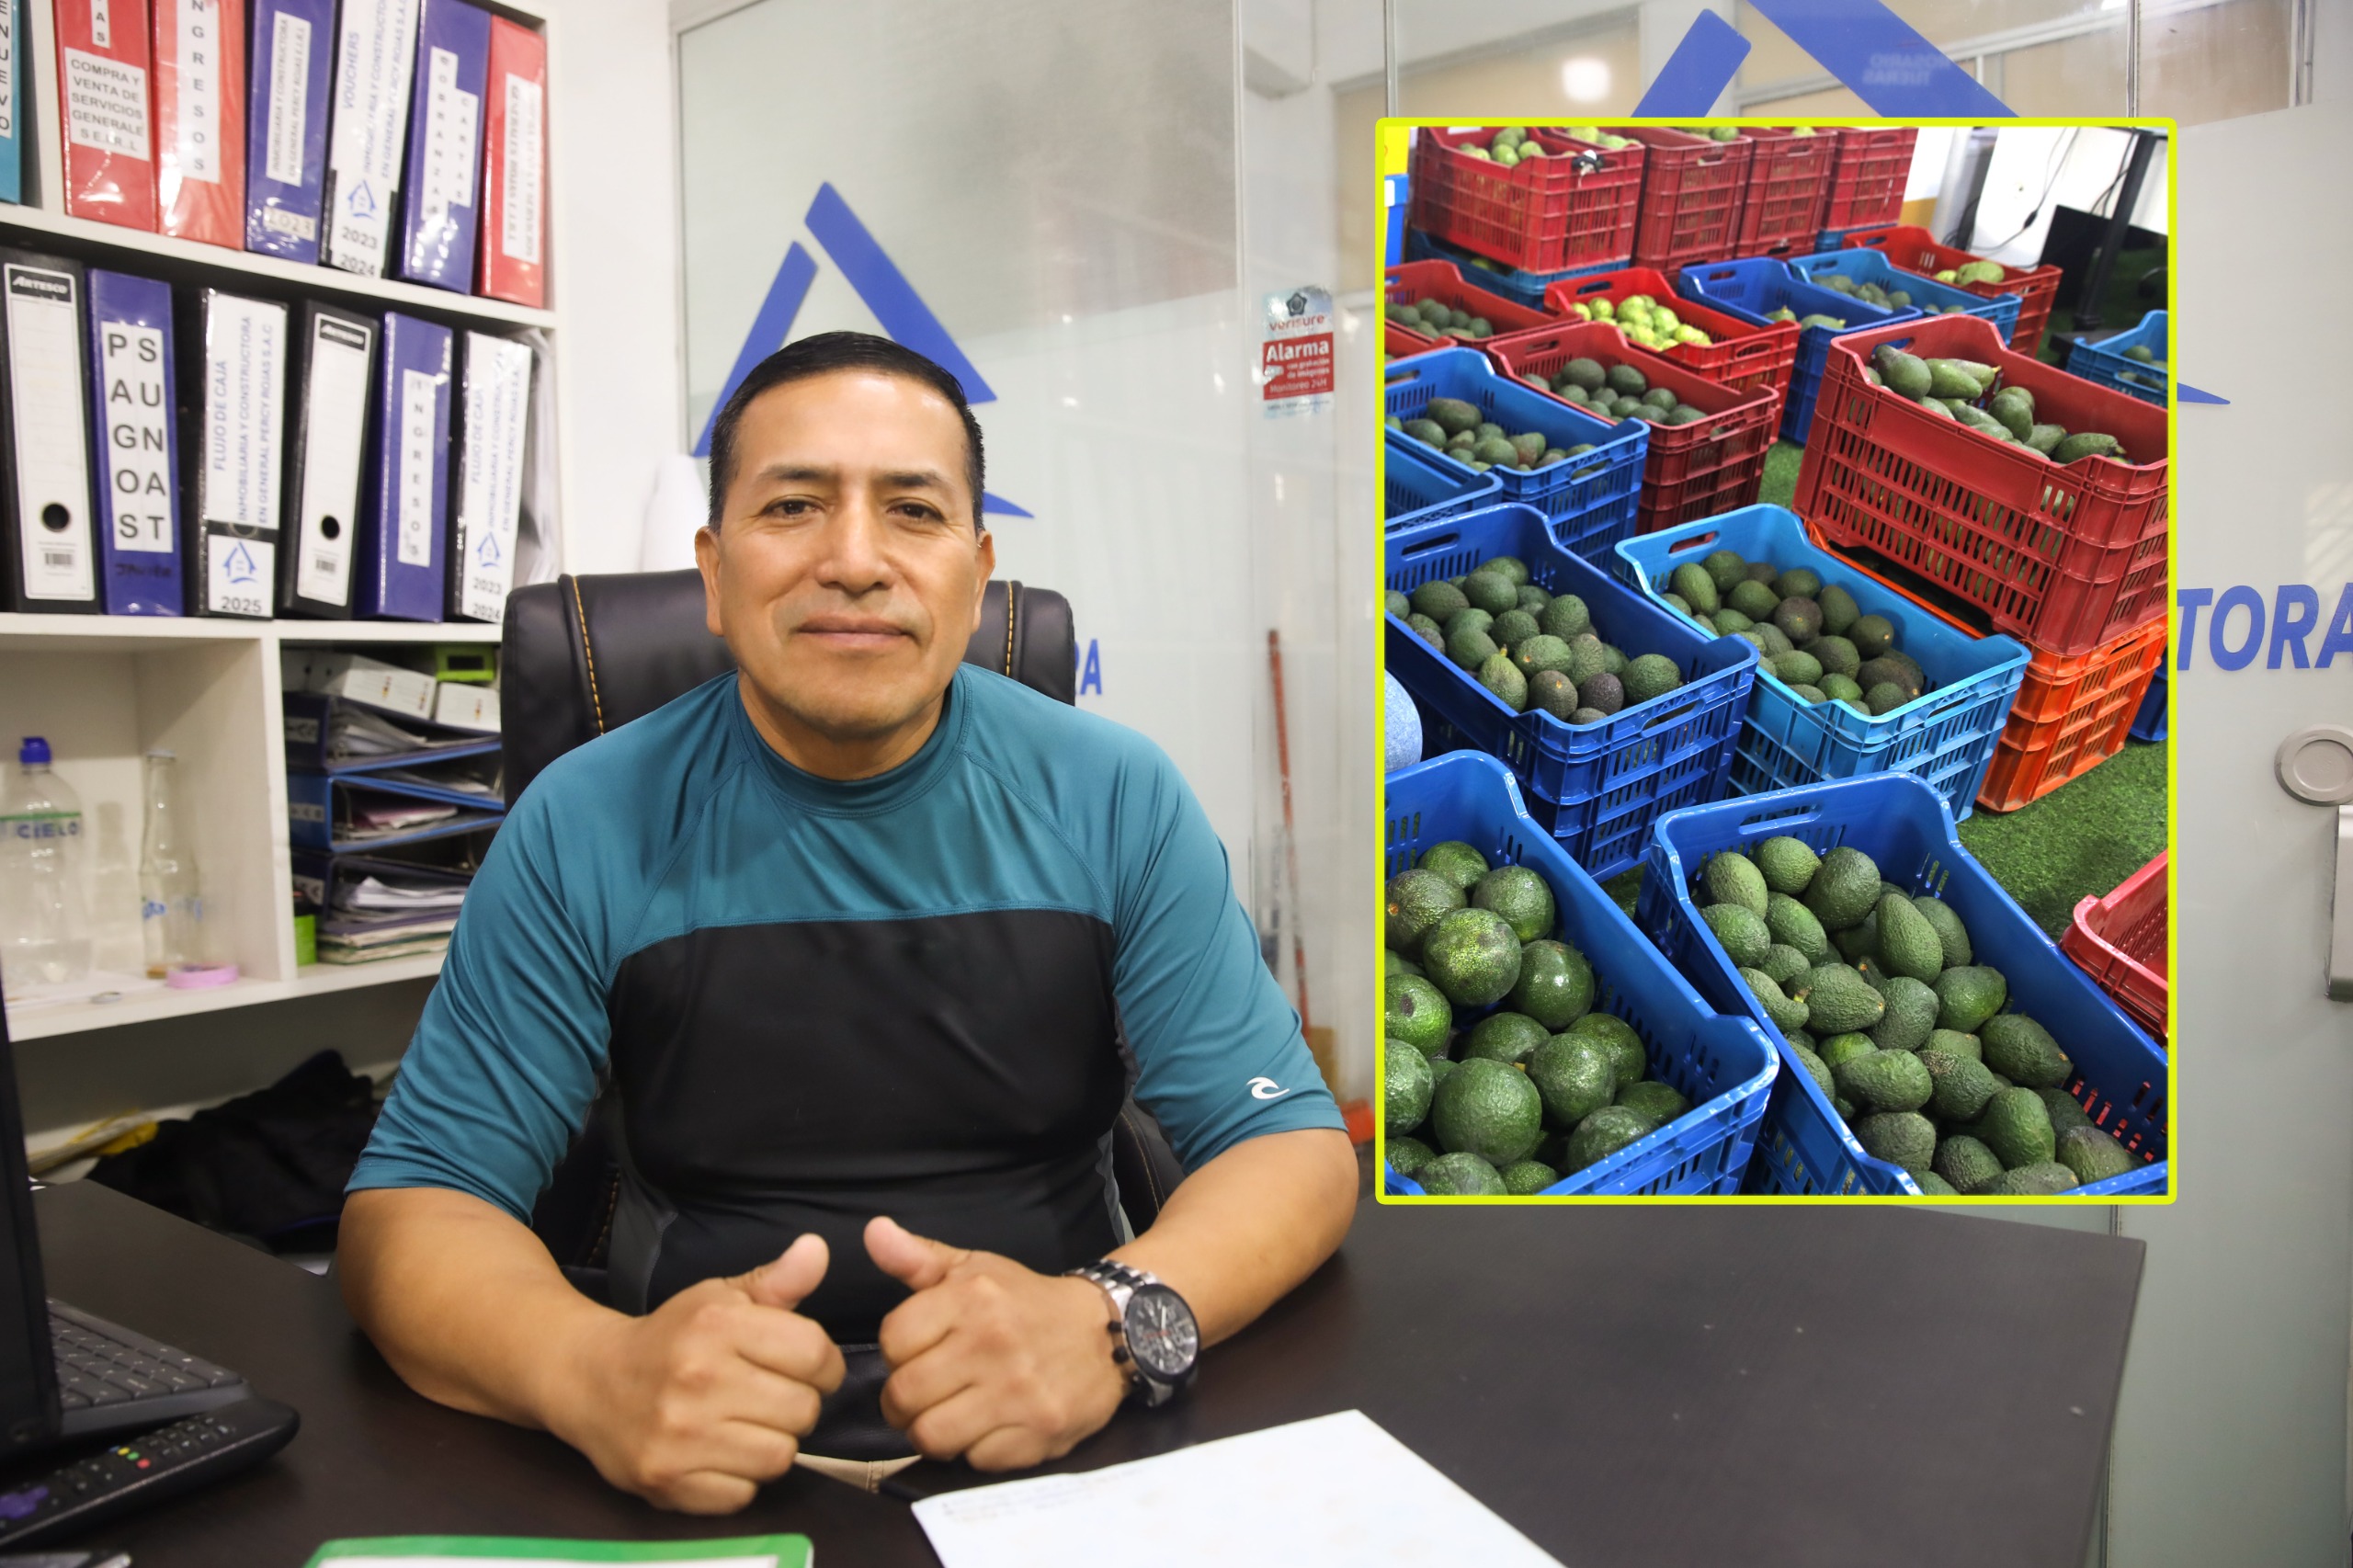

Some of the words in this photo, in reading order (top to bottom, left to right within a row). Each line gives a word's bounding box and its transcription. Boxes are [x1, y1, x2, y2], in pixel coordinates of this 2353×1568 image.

[71, 59, 130, 84] COMPRA
[132, 75, 140, 85] Y
[343, 31, 359, 109] VOUCHERS
[73, 75, 119, 97] VENTA
[121, 89, 139, 103] DE
[71, 92, 143, 120] SERVICIOS
[342, 225, 378, 250] 2023
[341, 254, 375, 276] 2024
[12, 276, 68, 294] ARTESCO
[1266, 340, 1329, 363] Alarma
[214, 360, 227, 398] CAJA
[238, 316, 252, 420] CONSTRUCTORA
[261, 361, 271, 399] ROJAS
[214, 402, 227, 422] DE
[260, 401, 271, 443] PERCY
[108, 333, 139, 540] PAGOS
[138, 337, 166, 540] SUNAT
[472, 424, 483, 441] DE
[213, 426, 227, 472] FLUJO
[237, 435, 249, 521] INMOBILIARIA
[258, 446, 268, 504] GENERAL
[472, 445, 483, 484] FLUJO
[258, 506, 267, 524] EN
[221, 596, 262, 613] 2025
[17, 822, 78, 839] CIELO
